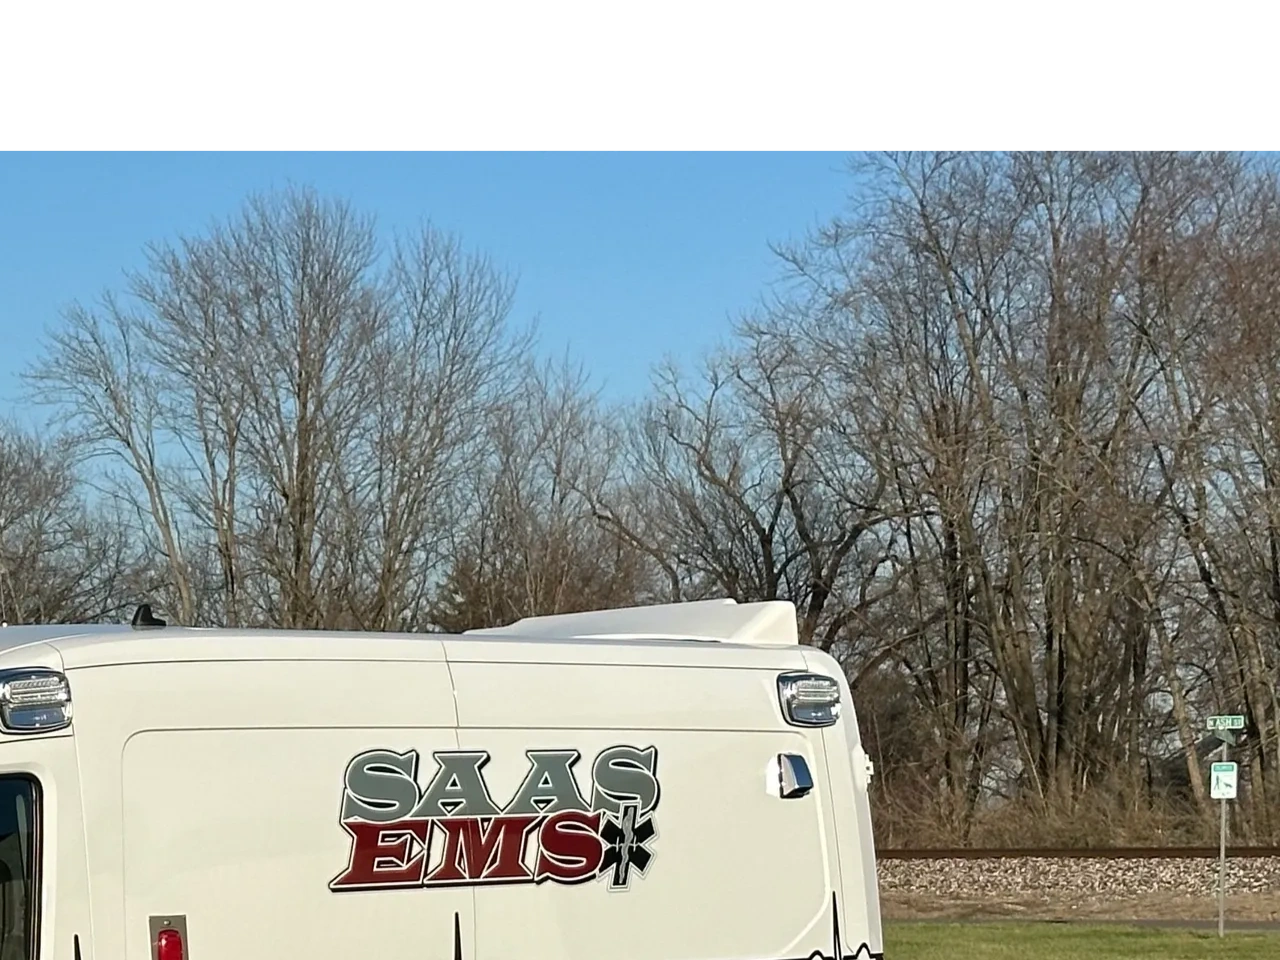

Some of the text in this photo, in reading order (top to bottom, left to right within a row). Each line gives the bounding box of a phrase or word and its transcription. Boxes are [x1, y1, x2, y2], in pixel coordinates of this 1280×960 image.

[1215, 717, 1232, 728] ASH
[340, 745, 660, 823] SAAS
[329, 810, 605, 892] EMS
